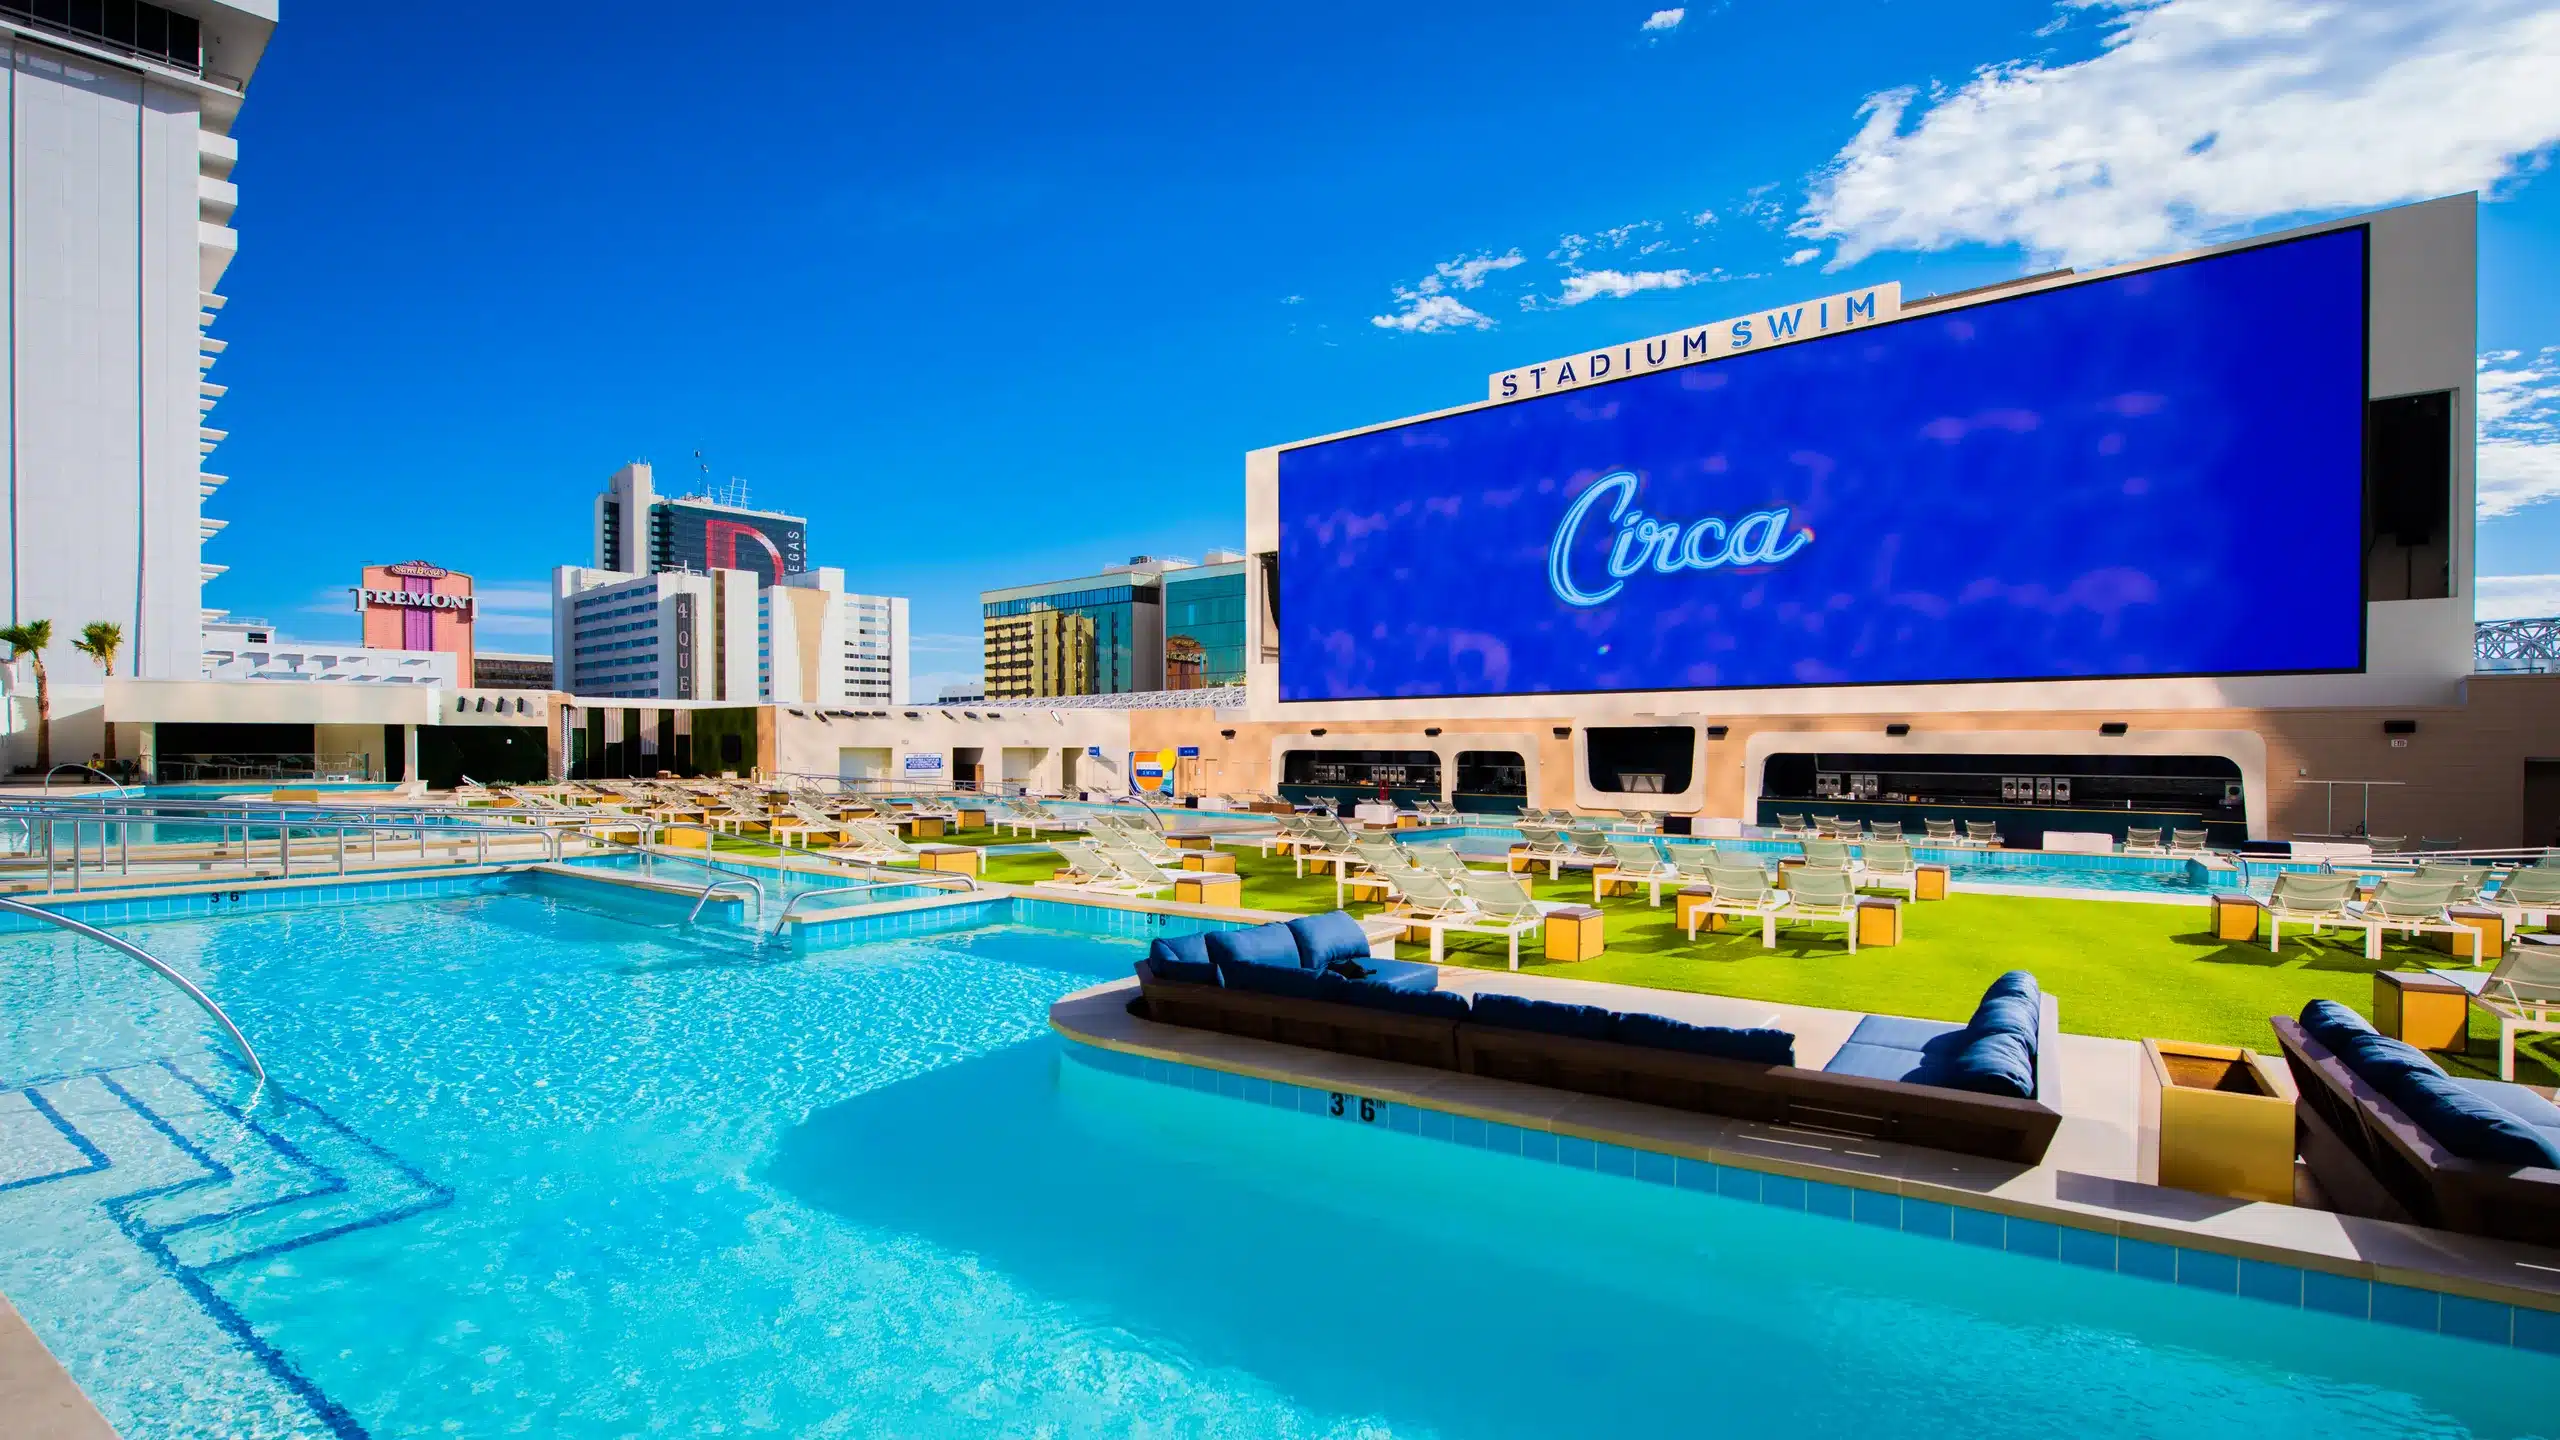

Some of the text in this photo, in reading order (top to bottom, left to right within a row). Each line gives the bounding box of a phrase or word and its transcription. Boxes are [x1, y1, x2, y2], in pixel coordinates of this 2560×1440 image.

[1501, 291, 1877, 398] STADIUM SWIM
[787, 530, 801, 572] EGAS
[1549, 471, 1816, 607] Circa
[349, 588, 483, 621] FREMONT
[677, 602, 690, 692] 4 QUE
